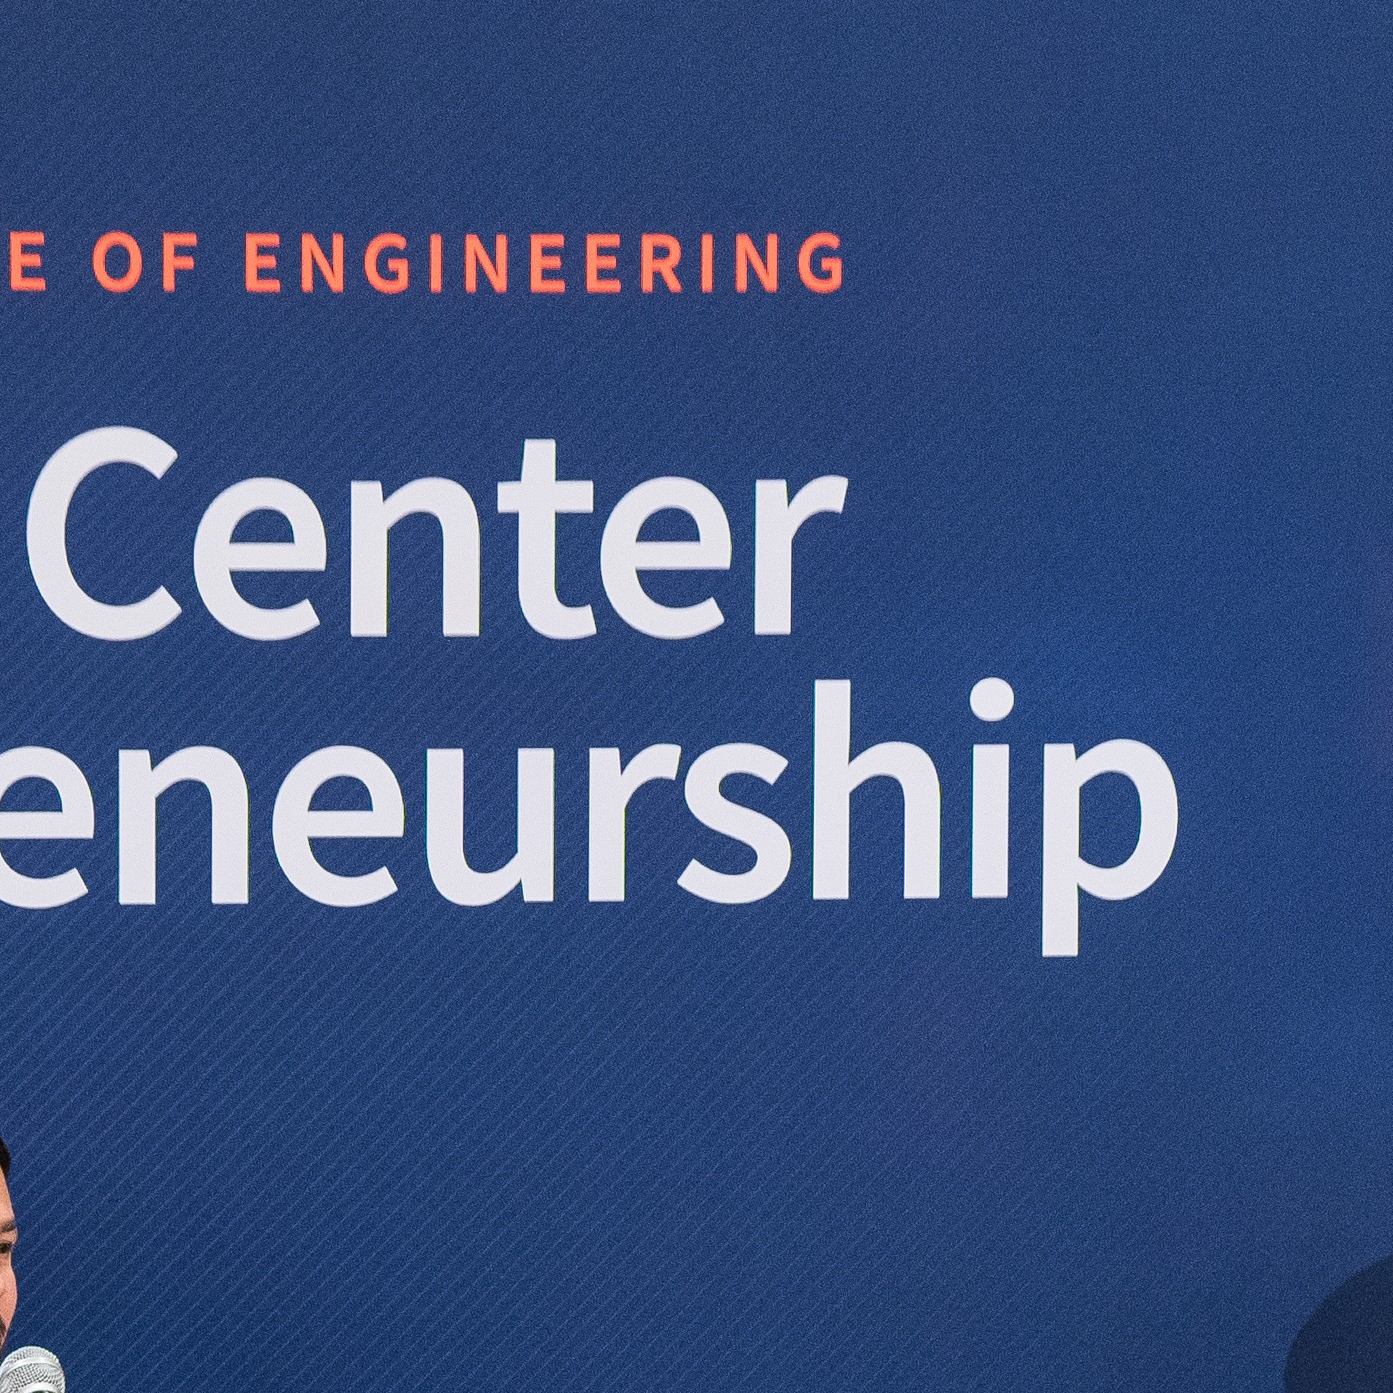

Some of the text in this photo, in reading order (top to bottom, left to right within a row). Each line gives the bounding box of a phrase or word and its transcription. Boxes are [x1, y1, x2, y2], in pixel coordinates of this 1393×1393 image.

[92, 229, 199, 294] OF
[244, 230, 844, 296] ENGINEERING
[26, 425, 849, 643] Center
